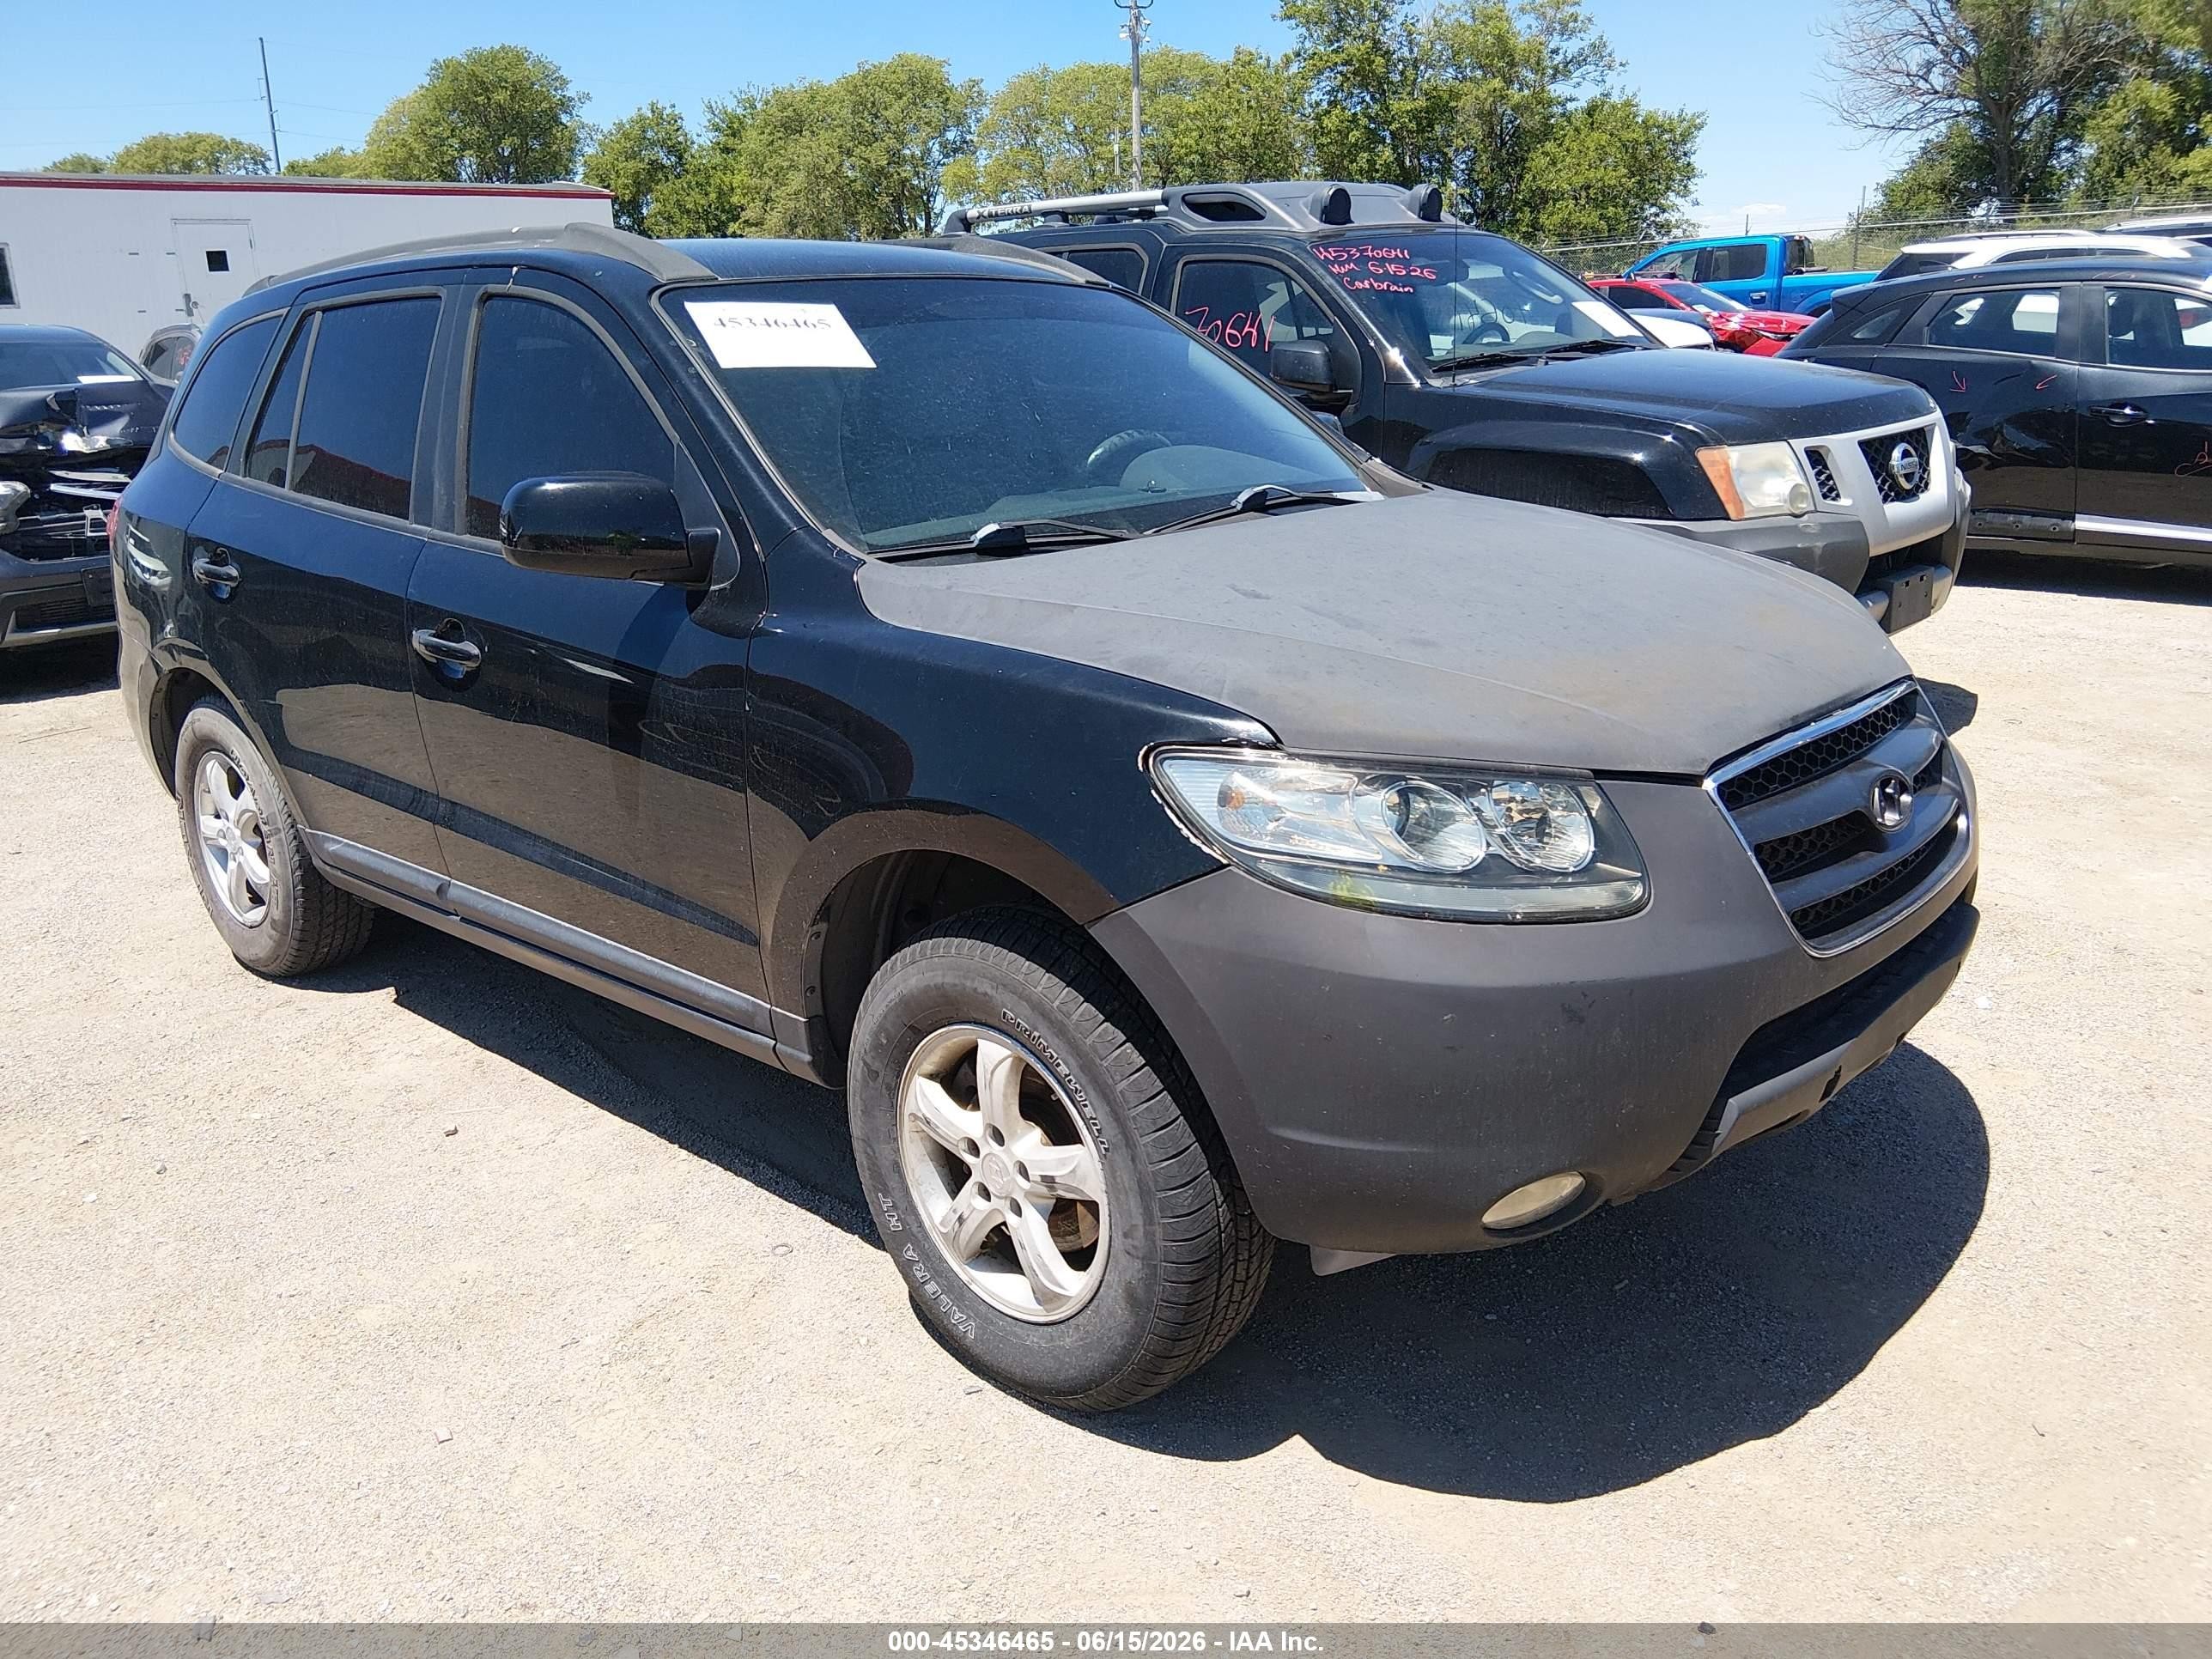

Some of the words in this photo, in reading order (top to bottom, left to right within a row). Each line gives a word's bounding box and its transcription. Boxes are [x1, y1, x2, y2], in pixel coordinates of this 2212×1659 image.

[975, 206, 1031, 220] XTERRA
[1001, 1008, 1110, 1156] PRIMEWELL
[878, 1193, 902, 1231] HT
[902, 1243, 975, 1340] VALERA
